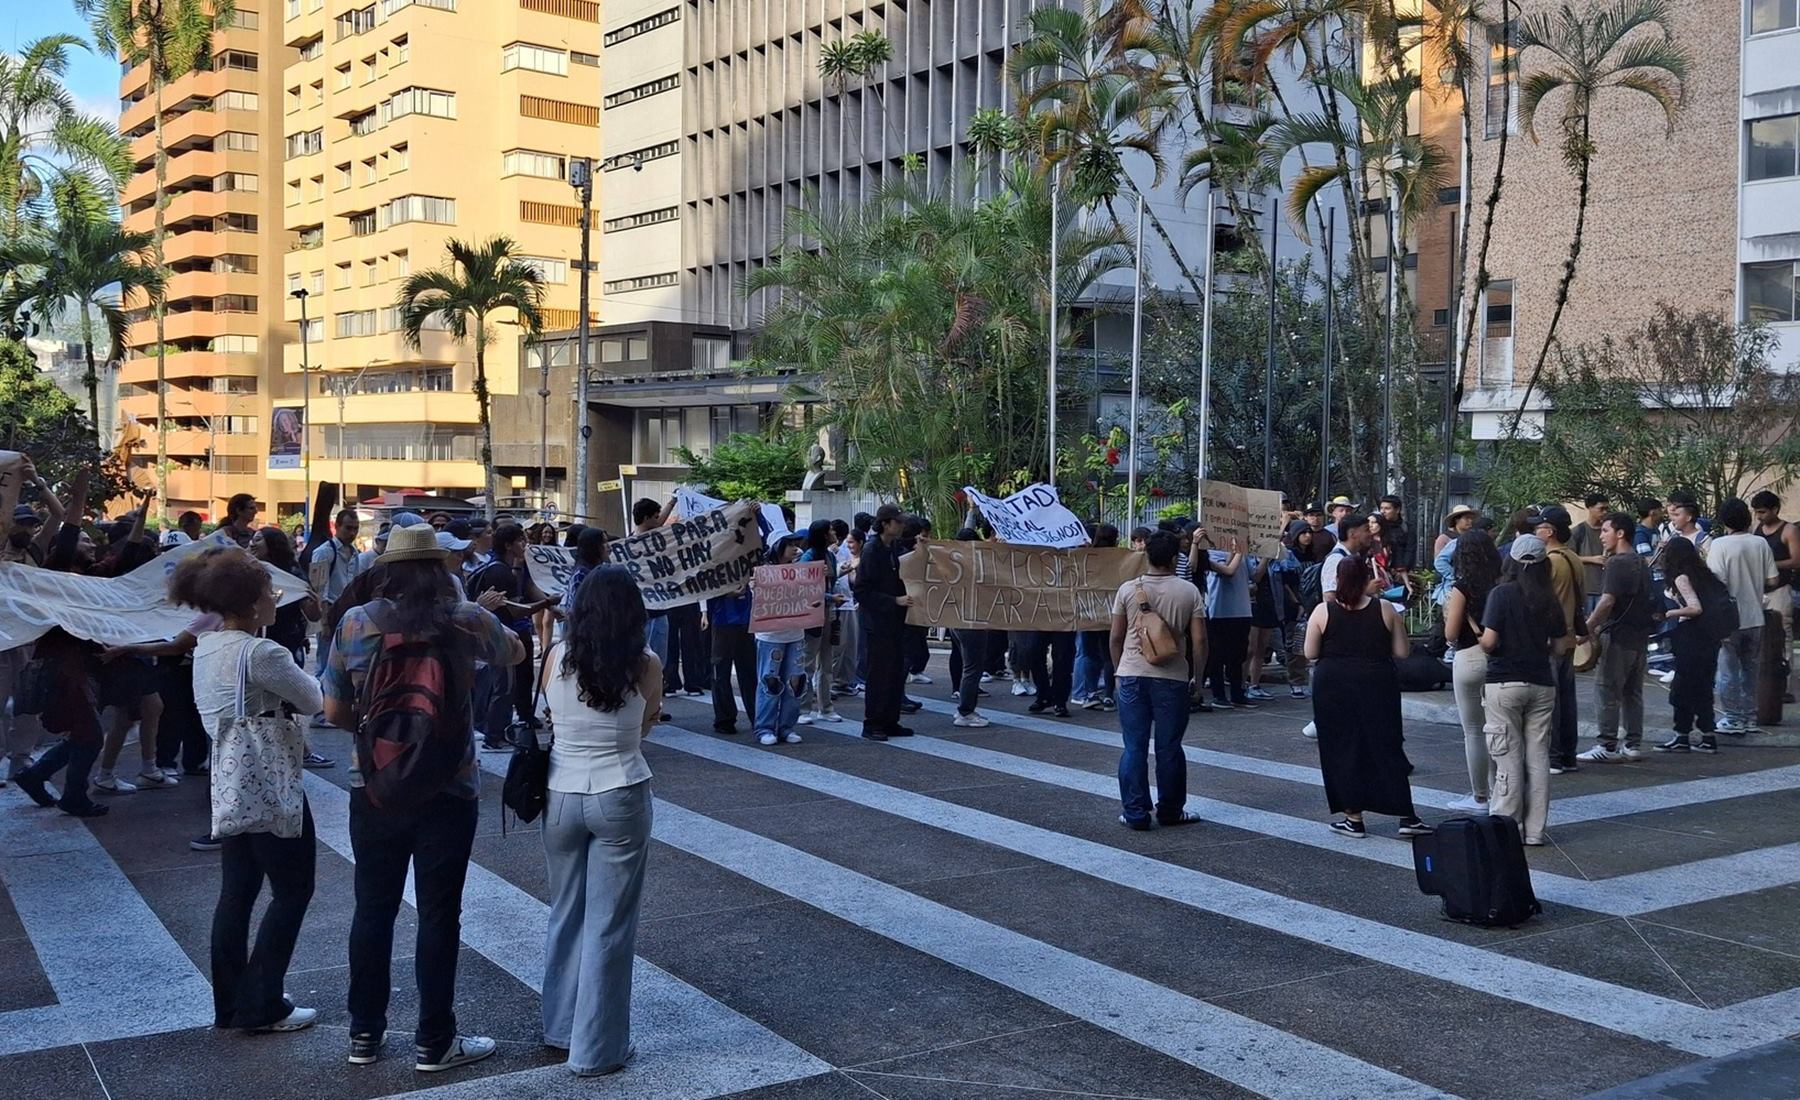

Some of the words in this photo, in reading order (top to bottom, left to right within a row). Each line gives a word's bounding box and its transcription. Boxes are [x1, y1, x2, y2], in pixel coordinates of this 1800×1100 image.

[671, 509, 729, 546] PARA
[647, 555, 675, 580] NO
[677, 540, 713, 571] HAY
[925, 545, 964, 585] ES
[642, 580, 685, 603] ARA
[753, 598, 810, 618] ESTUDIAR
[926, 585, 1023, 624] CALLAR
[1030, 589, 1052, 624] A
